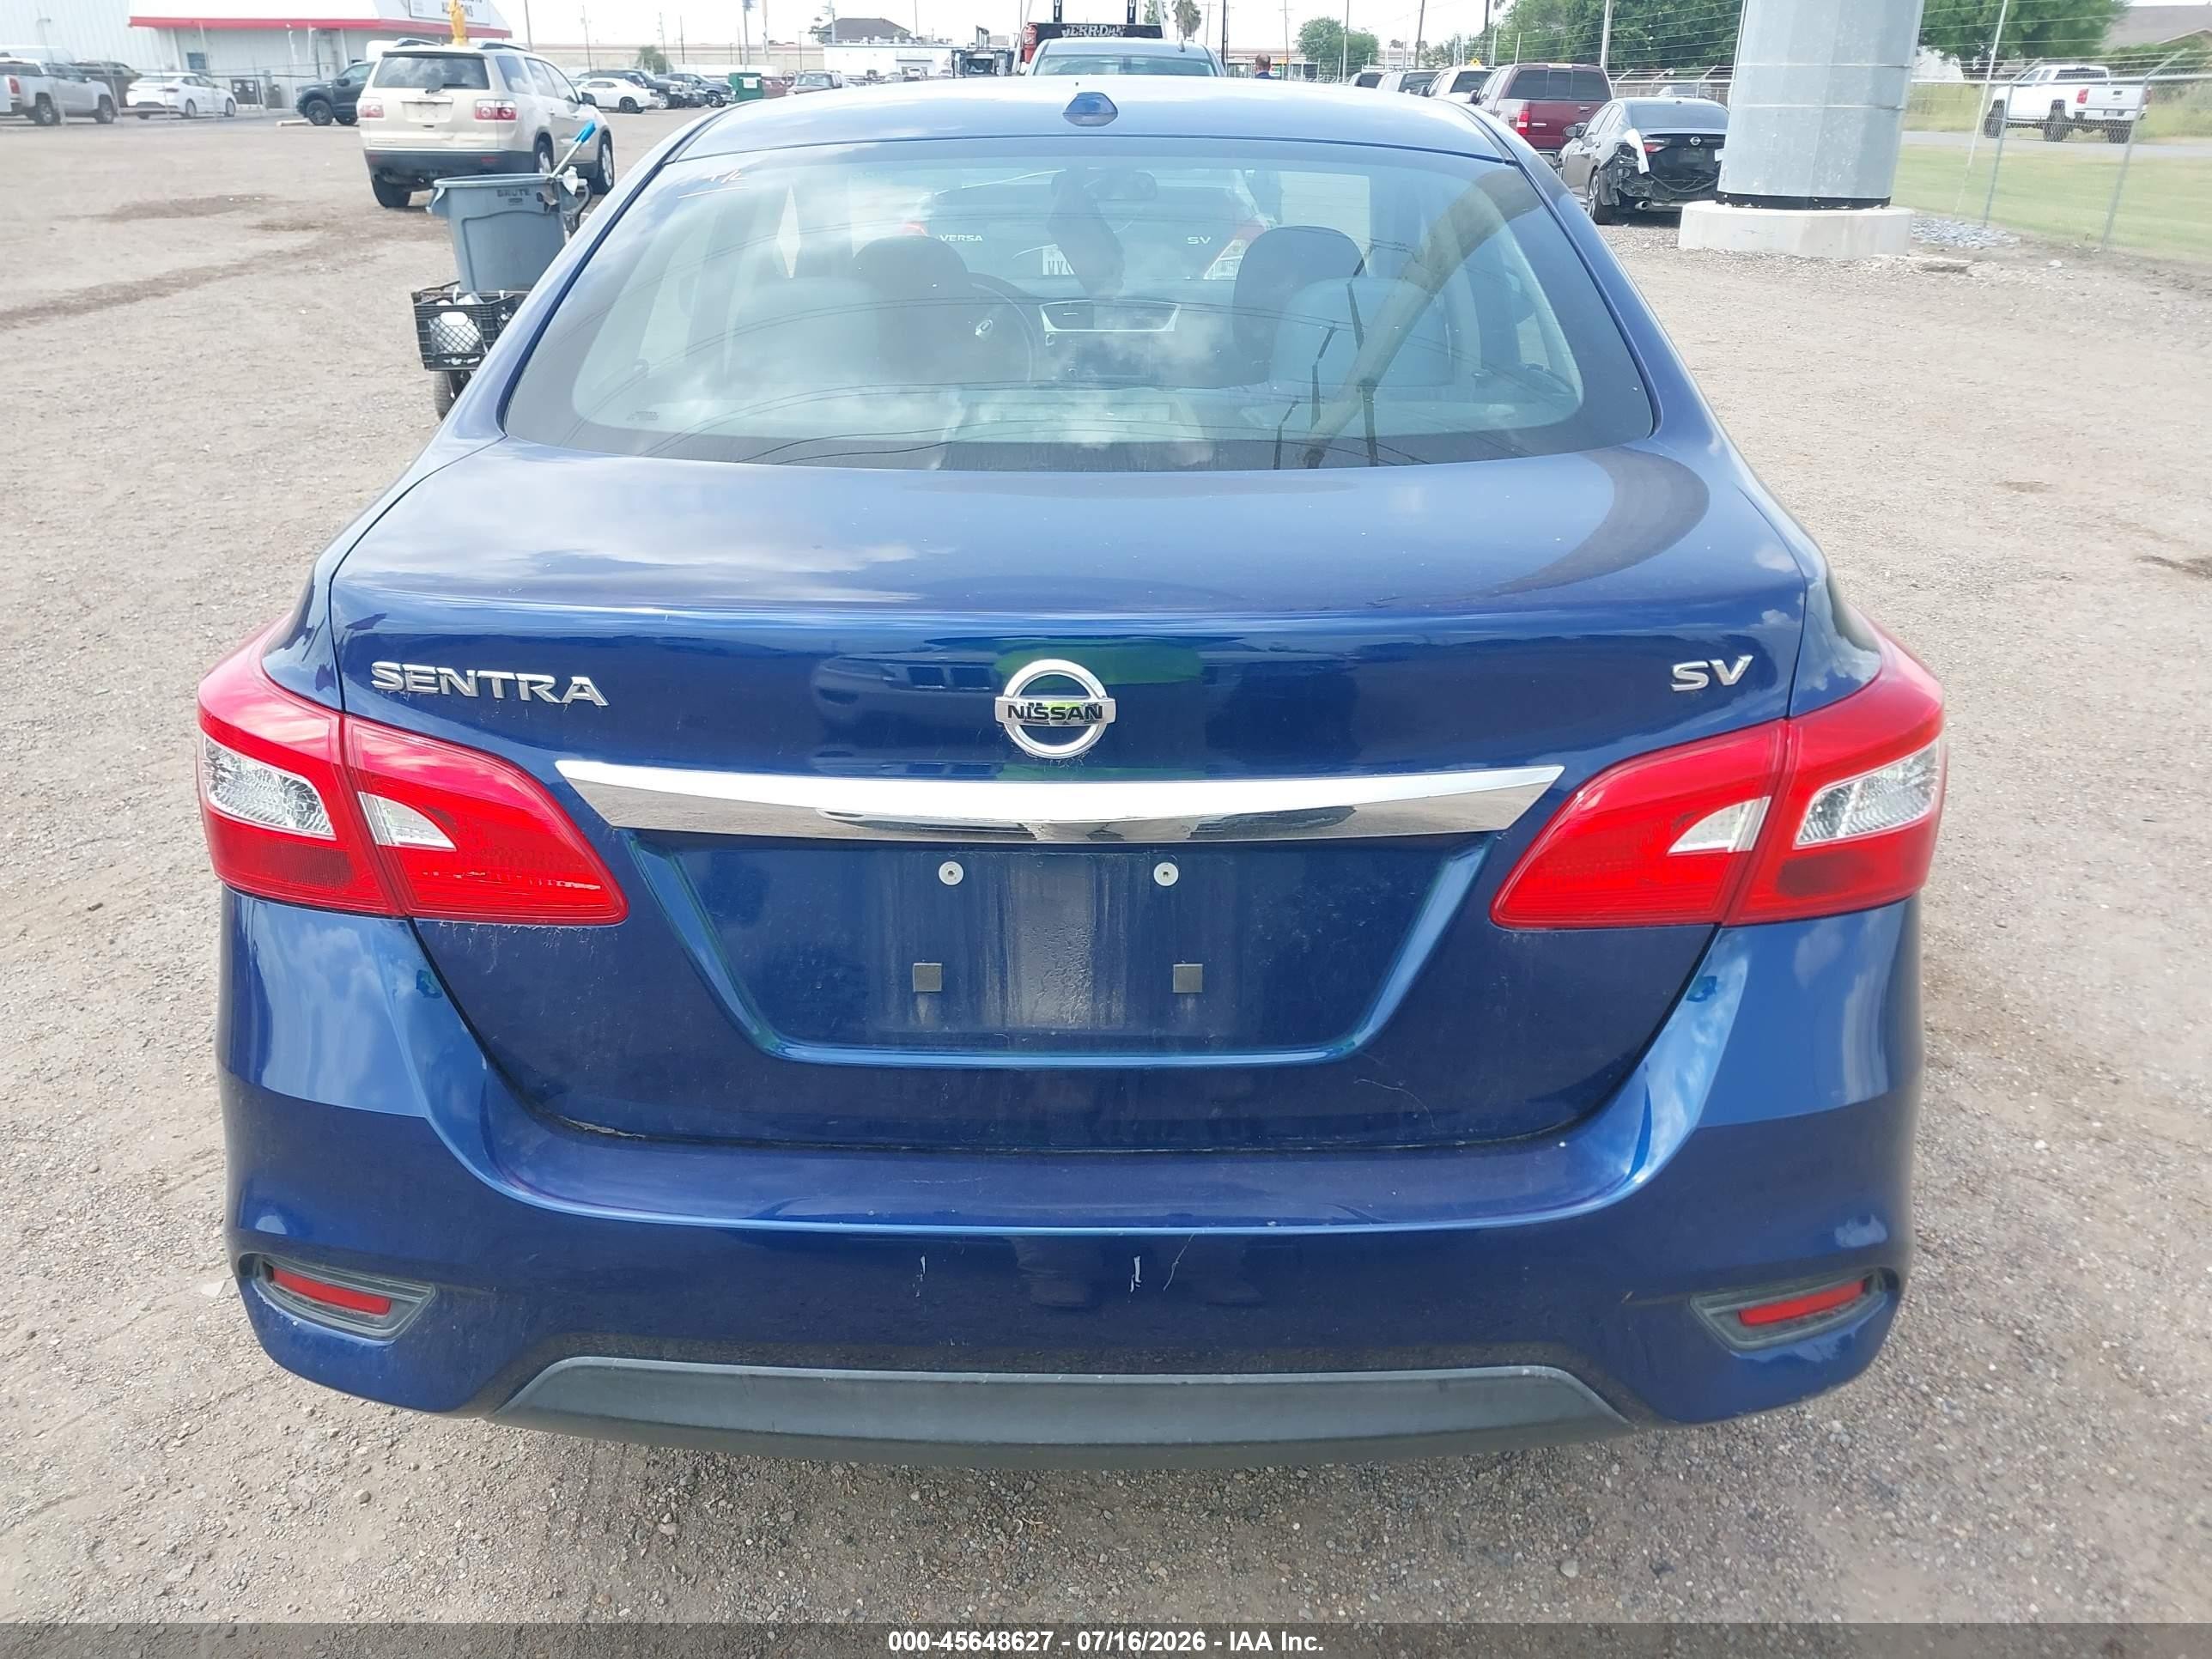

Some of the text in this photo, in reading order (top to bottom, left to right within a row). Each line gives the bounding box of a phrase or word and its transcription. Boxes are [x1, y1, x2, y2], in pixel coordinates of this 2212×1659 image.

[939, 234, 983, 242] VERSA
[1187, 236, 1211, 245] SV
[1670, 654, 1754, 692] SV
[371, 660, 611, 707] SENTRA
[1007, 703, 1103, 721] NISSAN
